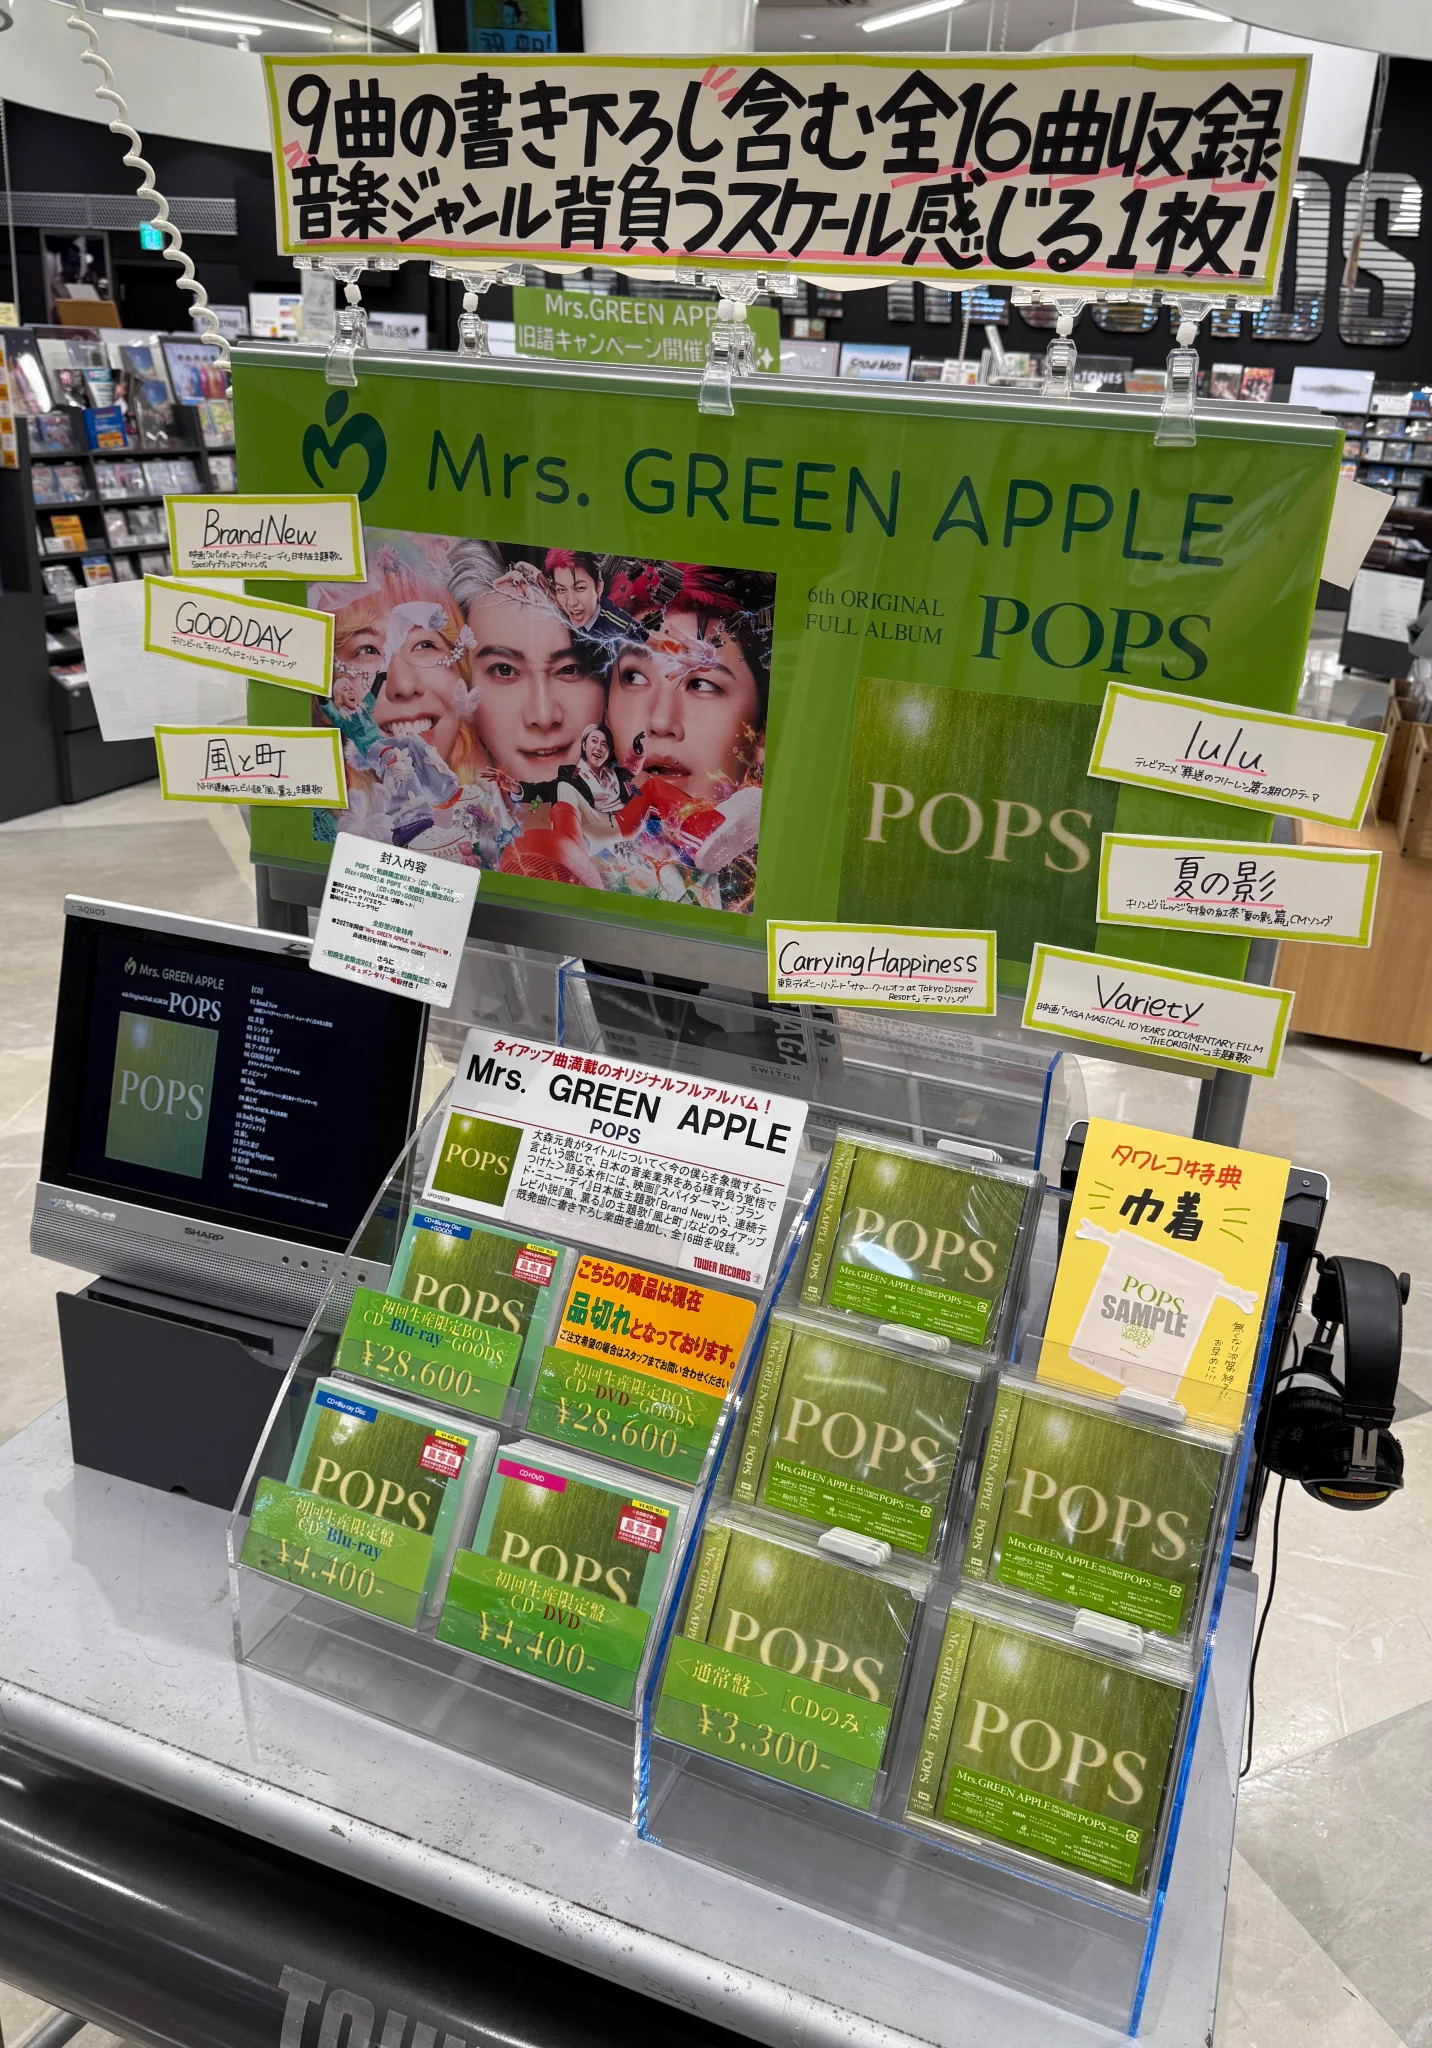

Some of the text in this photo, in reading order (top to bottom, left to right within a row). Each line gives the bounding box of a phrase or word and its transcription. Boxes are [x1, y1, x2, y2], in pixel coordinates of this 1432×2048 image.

[287, 67, 1284, 183] 9曲の書き下ろし含む全16曲収録
[292, 158, 1275, 278] 音楽ジャンル背負うスケール感じる1枚!
[546, 293, 664, 326] Mrs.GREEN
[518, 324, 712, 363] 旧譜キャンペーン開催
[427, 429, 1235, 567] Mrs. GREEN APPLE
[807, 586, 945, 617] 6th ORIGINAL
[805, 613, 943, 645] FULL ALBUM
[971, 594, 1212, 681] POPS
[205, 738, 287, 779] 風と町
[862, 781, 1093, 872] POPS
[379, 852, 427, 874] 封入内容
[1173, 856, 1277, 903] 夏の影
[77, 905, 107, 917] AQUOS
[138, 963, 225, 991] Mrs. GREEN APPLE
[168, 991, 222, 1022] POPS
[1096, 974, 1204, 1024] Variety
[1084, 1012, 1127, 1029] MAGICAL
[1139, 1024, 1166, 1037] YEARS
[1167, 1028, 1235, 1049] DOCUMENTARY
[1236, 1042, 1264, 1054] FILM
[750, 1065, 801, 1082] SWITCH
[118, 1069, 205, 1121] POPS
[466, 1054, 792, 1154] Mrs. GREEN APPLE
[588, 1118, 642, 1145] POPS
[444, 1142, 511, 1177] POPS
[1111, 1144, 1243, 1191] タワレコ特典
[184, 1226, 225, 1241] SHARP
[1119, 1188, 1204, 1242] 巾着
[809, 1251, 822, 1280] POPS
[852, 1206, 998, 1284] POPS
[578, 1259, 702, 1313] こちらの商品は現在
[694, 1256, 752, 1281] TOWER RECORDS
[412, 1272, 526, 1335] POPS
[888, 1277, 917, 1293] APPLE
[937, 1291, 962, 1306] POPS
[1120, 1275, 1185, 1316] POPS
[566, 1291, 737, 1369] 品切れとなっております。
[1100, 1293, 1189, 1338] SAMPLE
[1124, 1325, 1152, 1342] GREEN
[1121, 1331, 1148, 1349] APPLE
[760, 1358, 777, 1401] GREEN
[752, 1401, 766, 1438] APPLE
[742, 1444, 756, 1475] POPS
[782, 1396, 941, 1485] POPS
[310, 1456, 432, 1532] POPS
[519, 1468, 546, 1483] CD+DVD
[826, 1477, 904, 1509] APPLE POPS
[971, 1519, 987, 1551] POPS
[1014, 1467, 1190, 1562] POPS
[500, 1530, 632, 1604] POPS
[1065, 1554, 1152, 1588] APPLE POPS
[695, 1568, 711, 1614] GREEN
[722, 1607, 884, 1703] POPS
[919, 1749, 935, 1784] POPS
[963, 1698, 1148, 1806] POPS
[1016, 1791, 1051, 1811] APPLE
[1077, 1813, 1107, 1831] POPS
